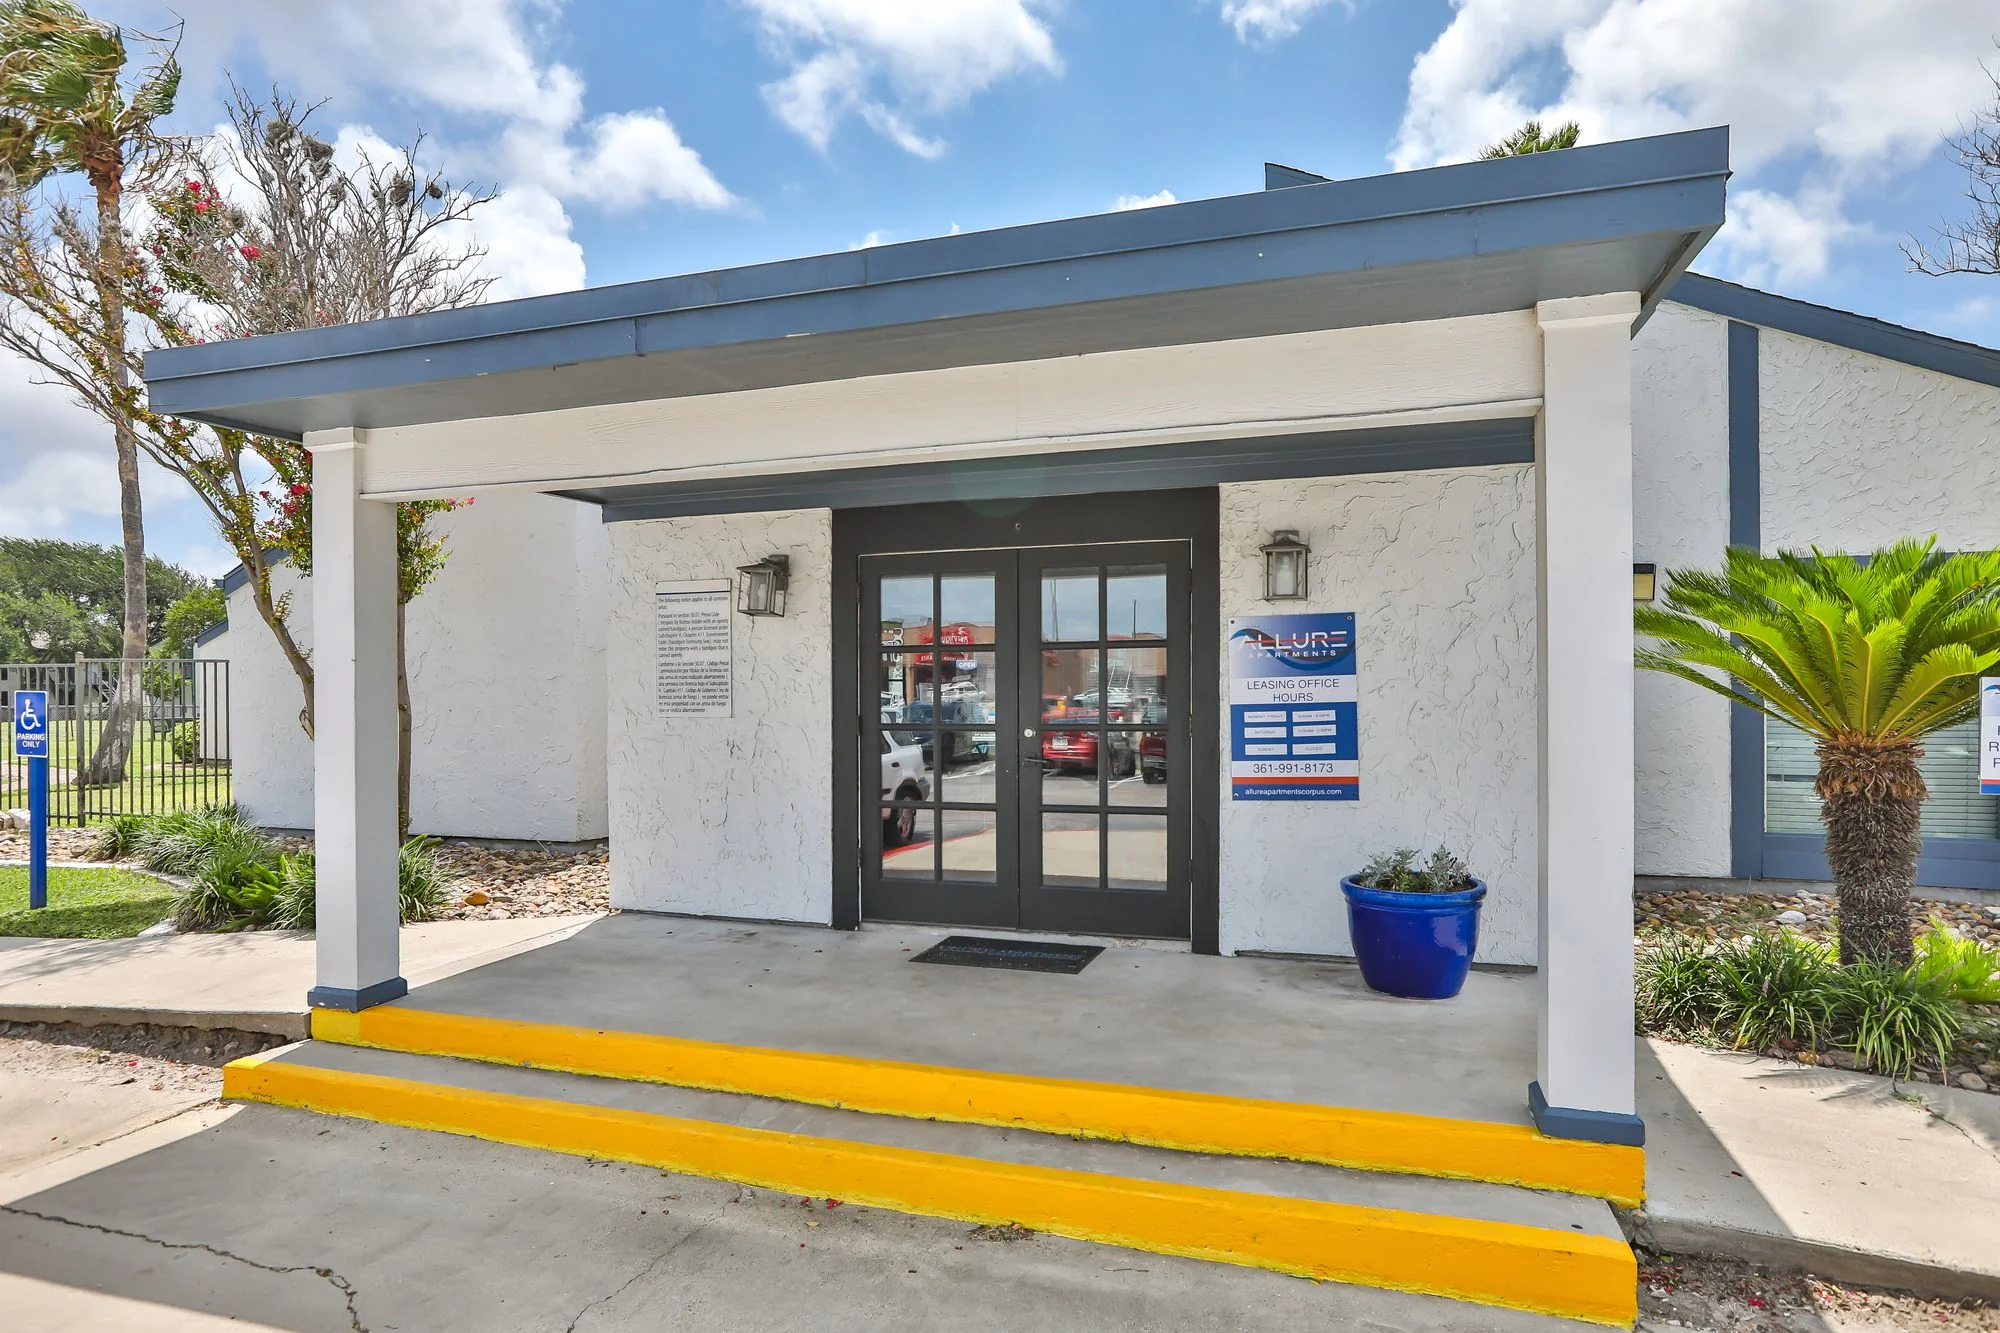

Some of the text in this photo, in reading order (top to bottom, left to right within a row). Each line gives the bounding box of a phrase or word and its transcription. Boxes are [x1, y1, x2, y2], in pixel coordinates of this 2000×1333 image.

[1239, 630, 1348, 650] ALLURE
[1248, 650, 1336, 659] APARTMENTS
[1247, 678, 1340, 690] LEASING OFFICE
[1273, 692, 1314, 702] HOURS
[1253, 763, 1334, 774] 361-991-8173
